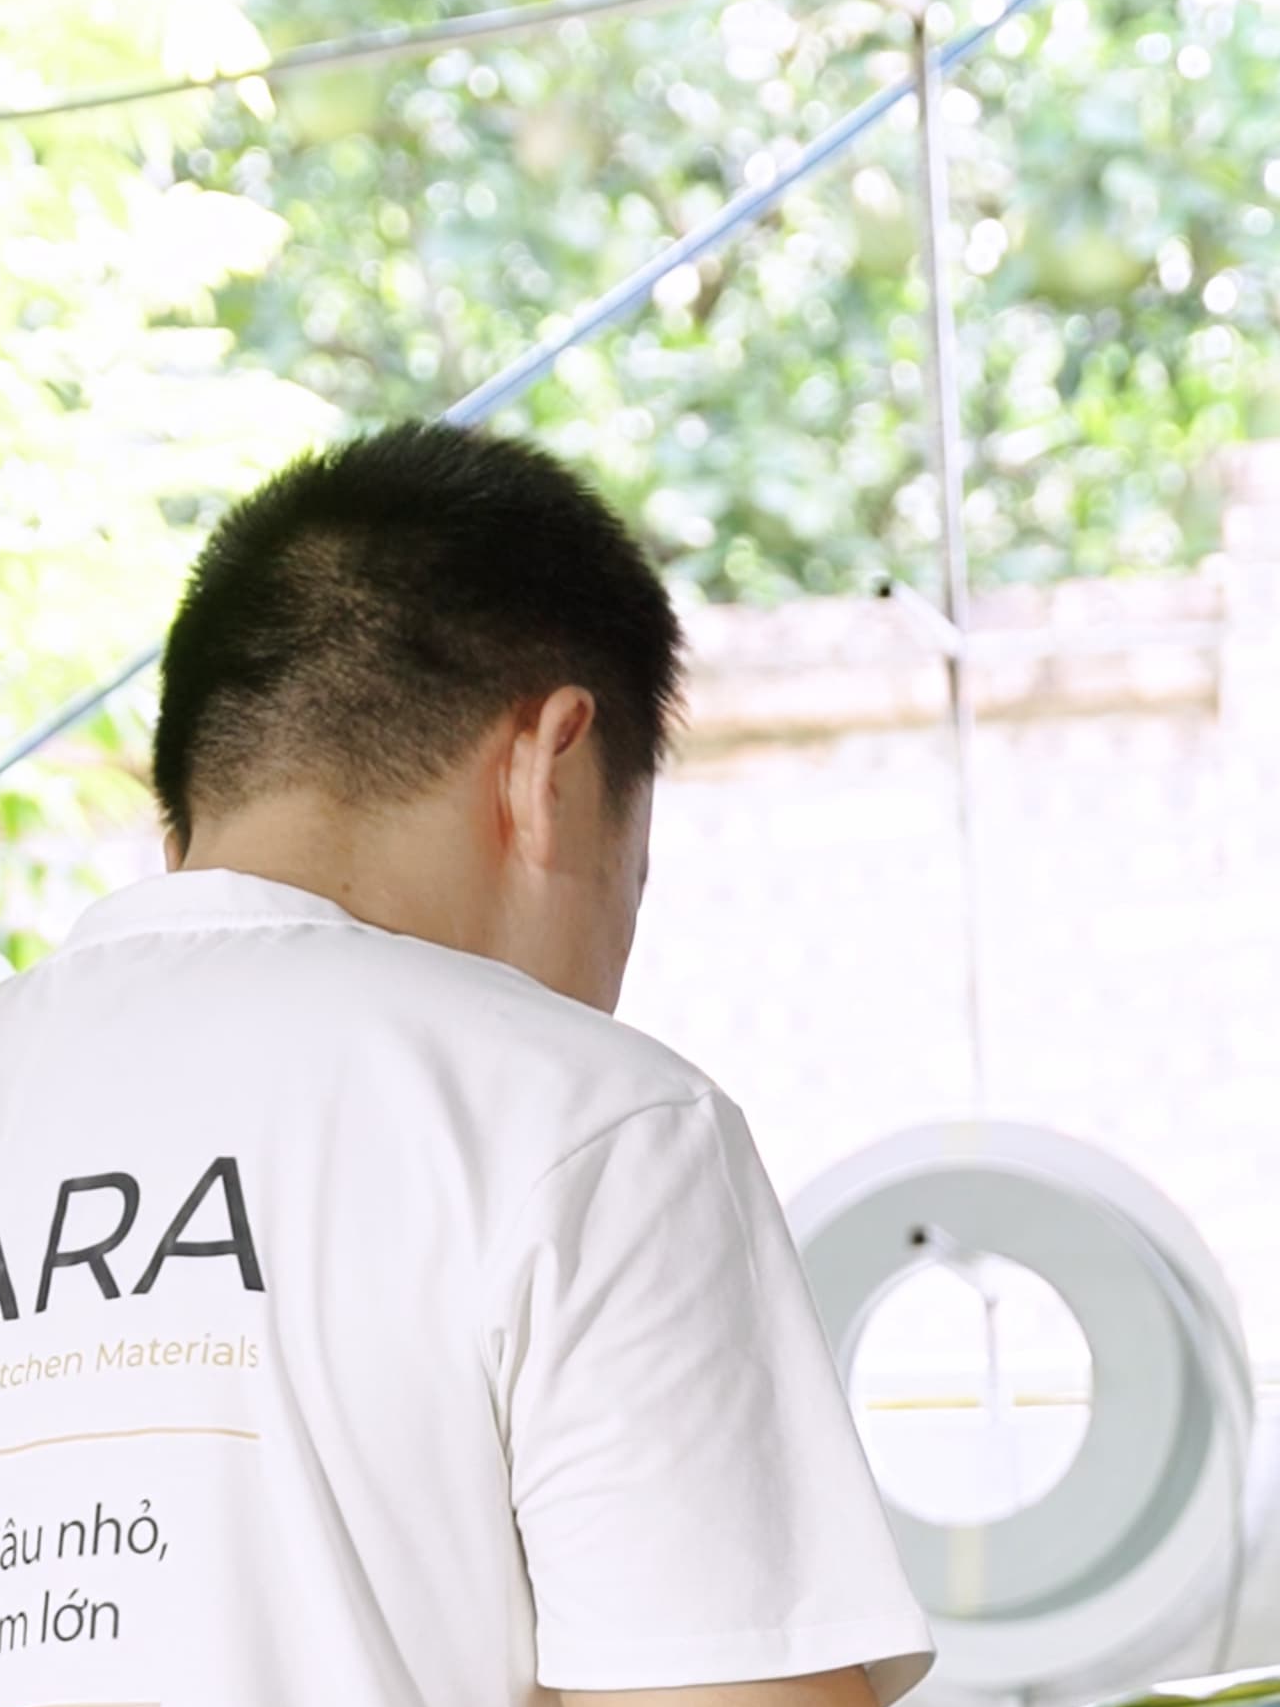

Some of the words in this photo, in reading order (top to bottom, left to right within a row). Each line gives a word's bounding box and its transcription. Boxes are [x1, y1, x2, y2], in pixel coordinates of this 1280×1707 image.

[95, 1332, 259, 1372] Materials
[57, 1498, 169, 1562] nhỏ,
[40, 1587, 120, 1644] lớn
